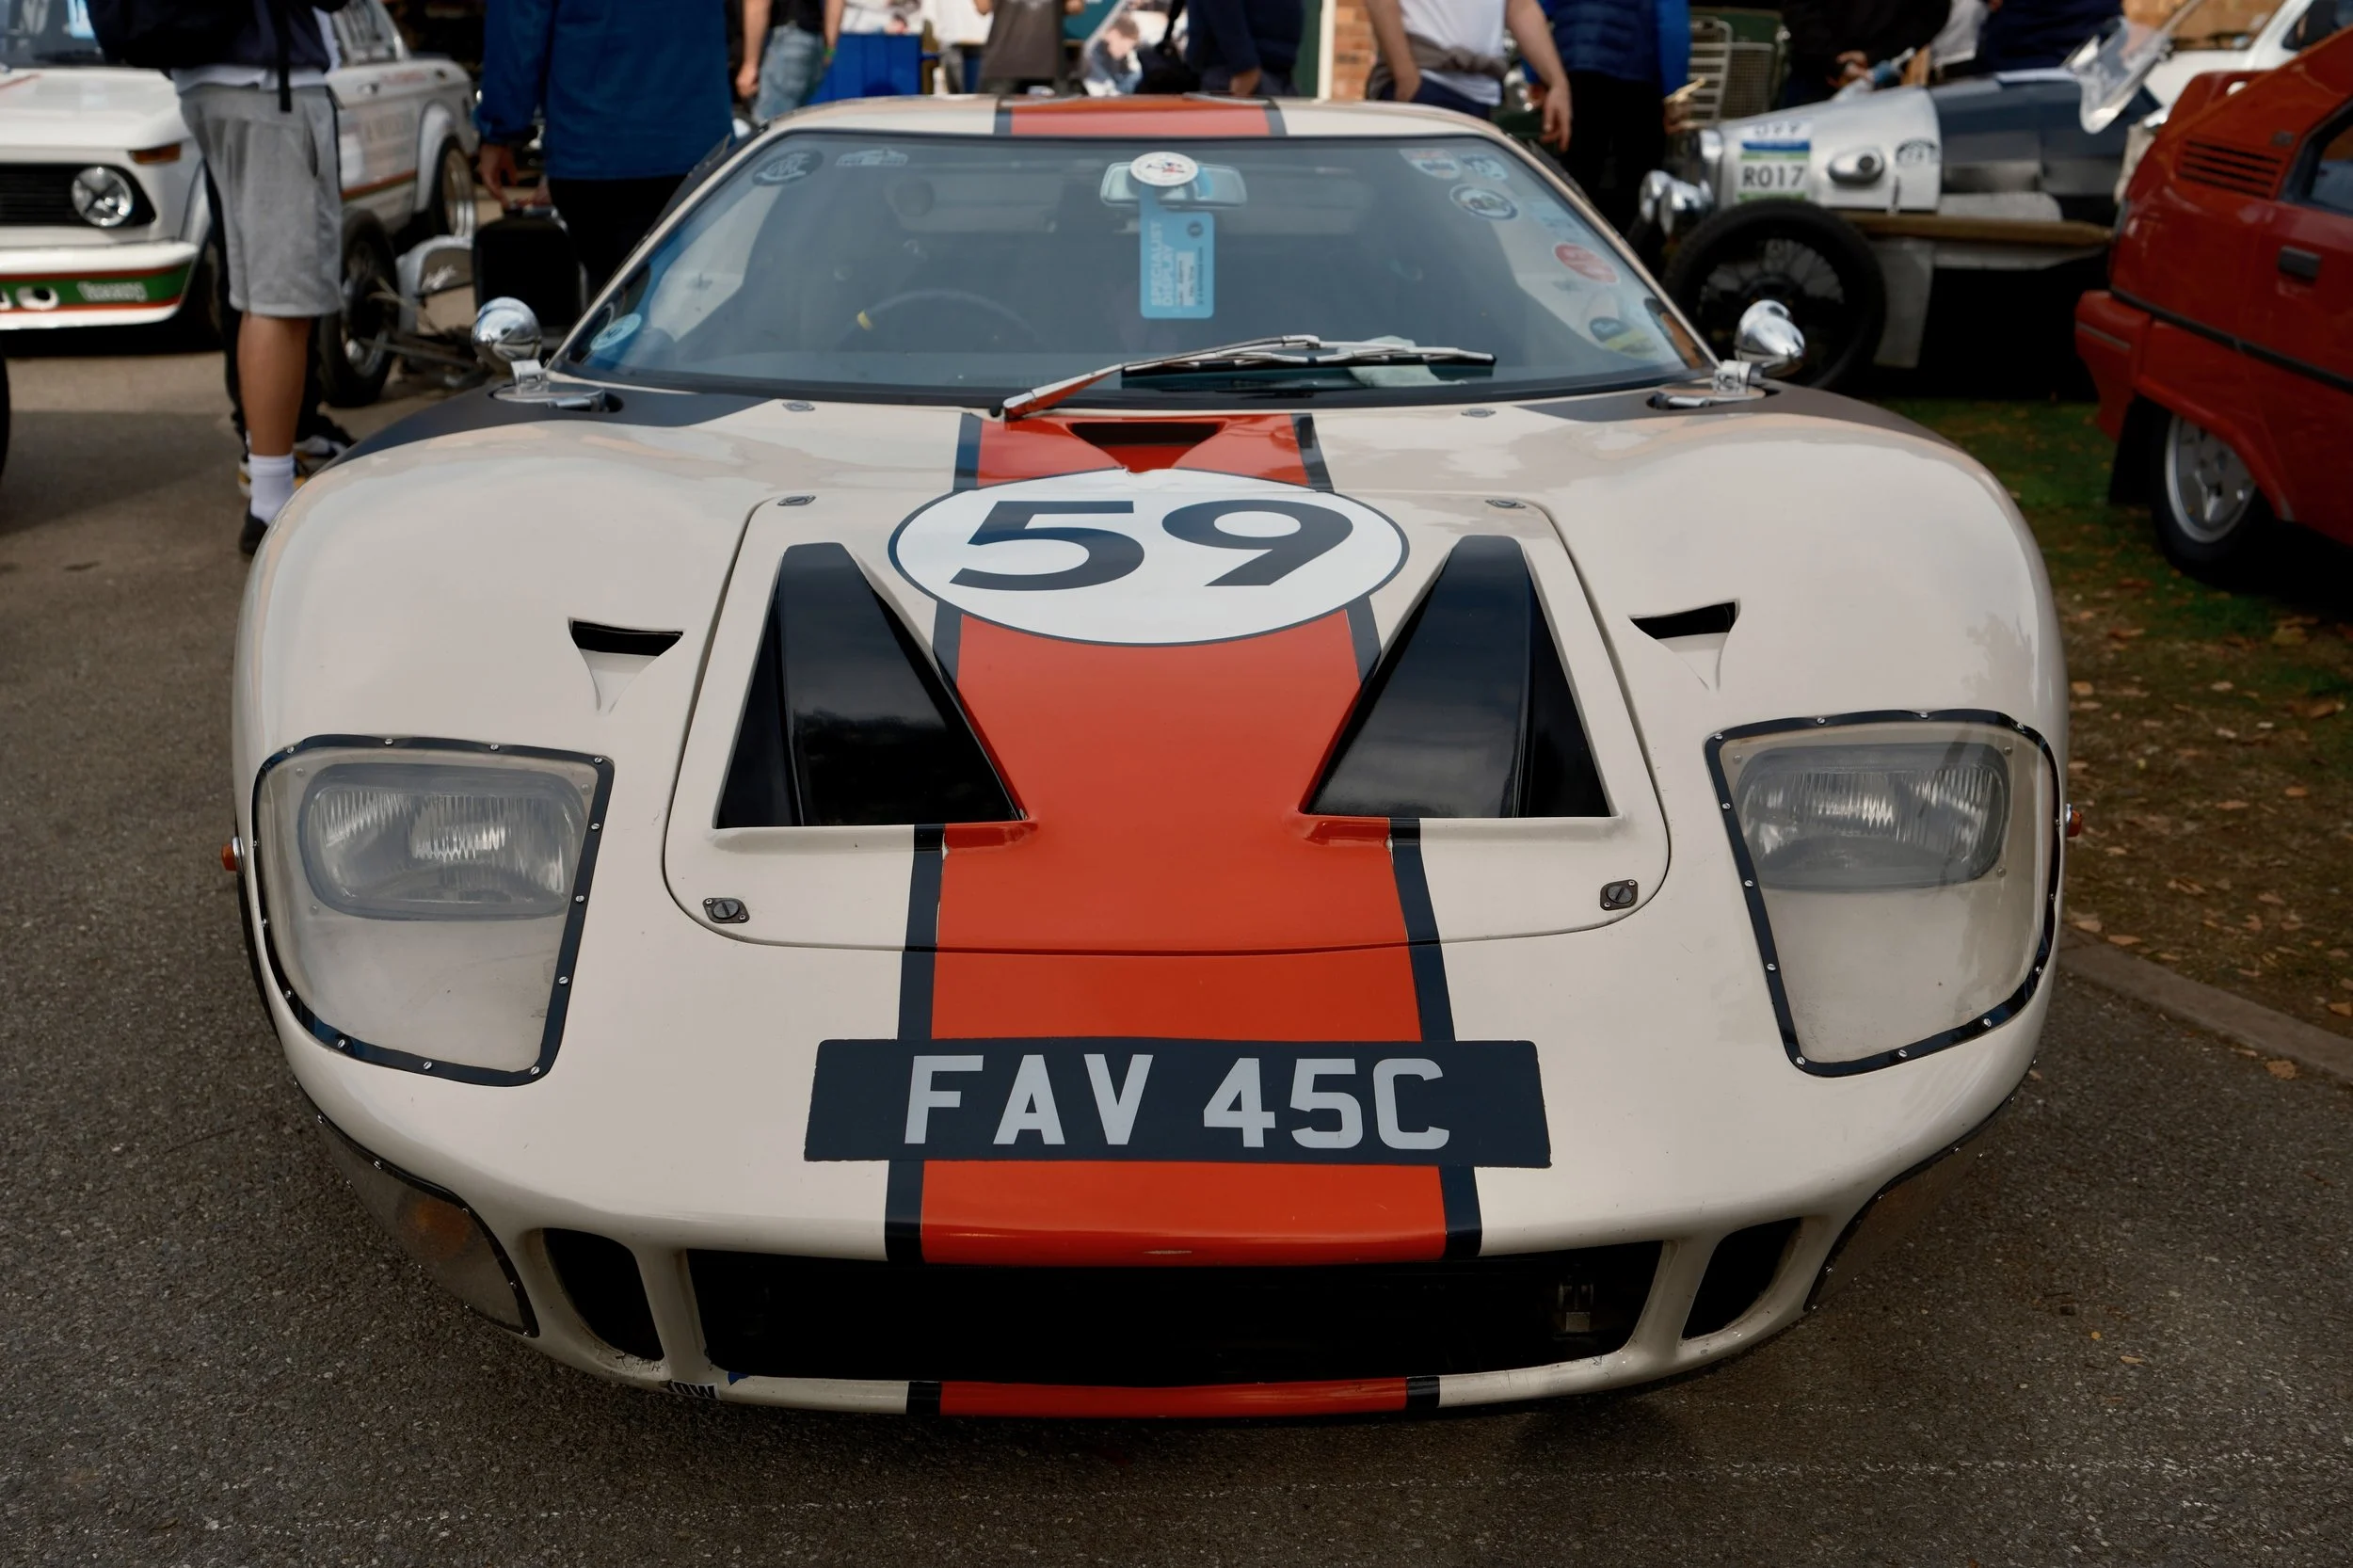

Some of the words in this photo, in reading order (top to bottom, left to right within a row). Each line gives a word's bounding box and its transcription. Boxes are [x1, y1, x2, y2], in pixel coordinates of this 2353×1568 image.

[1162, 245, 1175, 306] DISPLAY
[949, 499, 1353, 591] 59
[904, 1053, 1154, 1145] FAV
[1203, 1057, 1450, 1151] 45C
